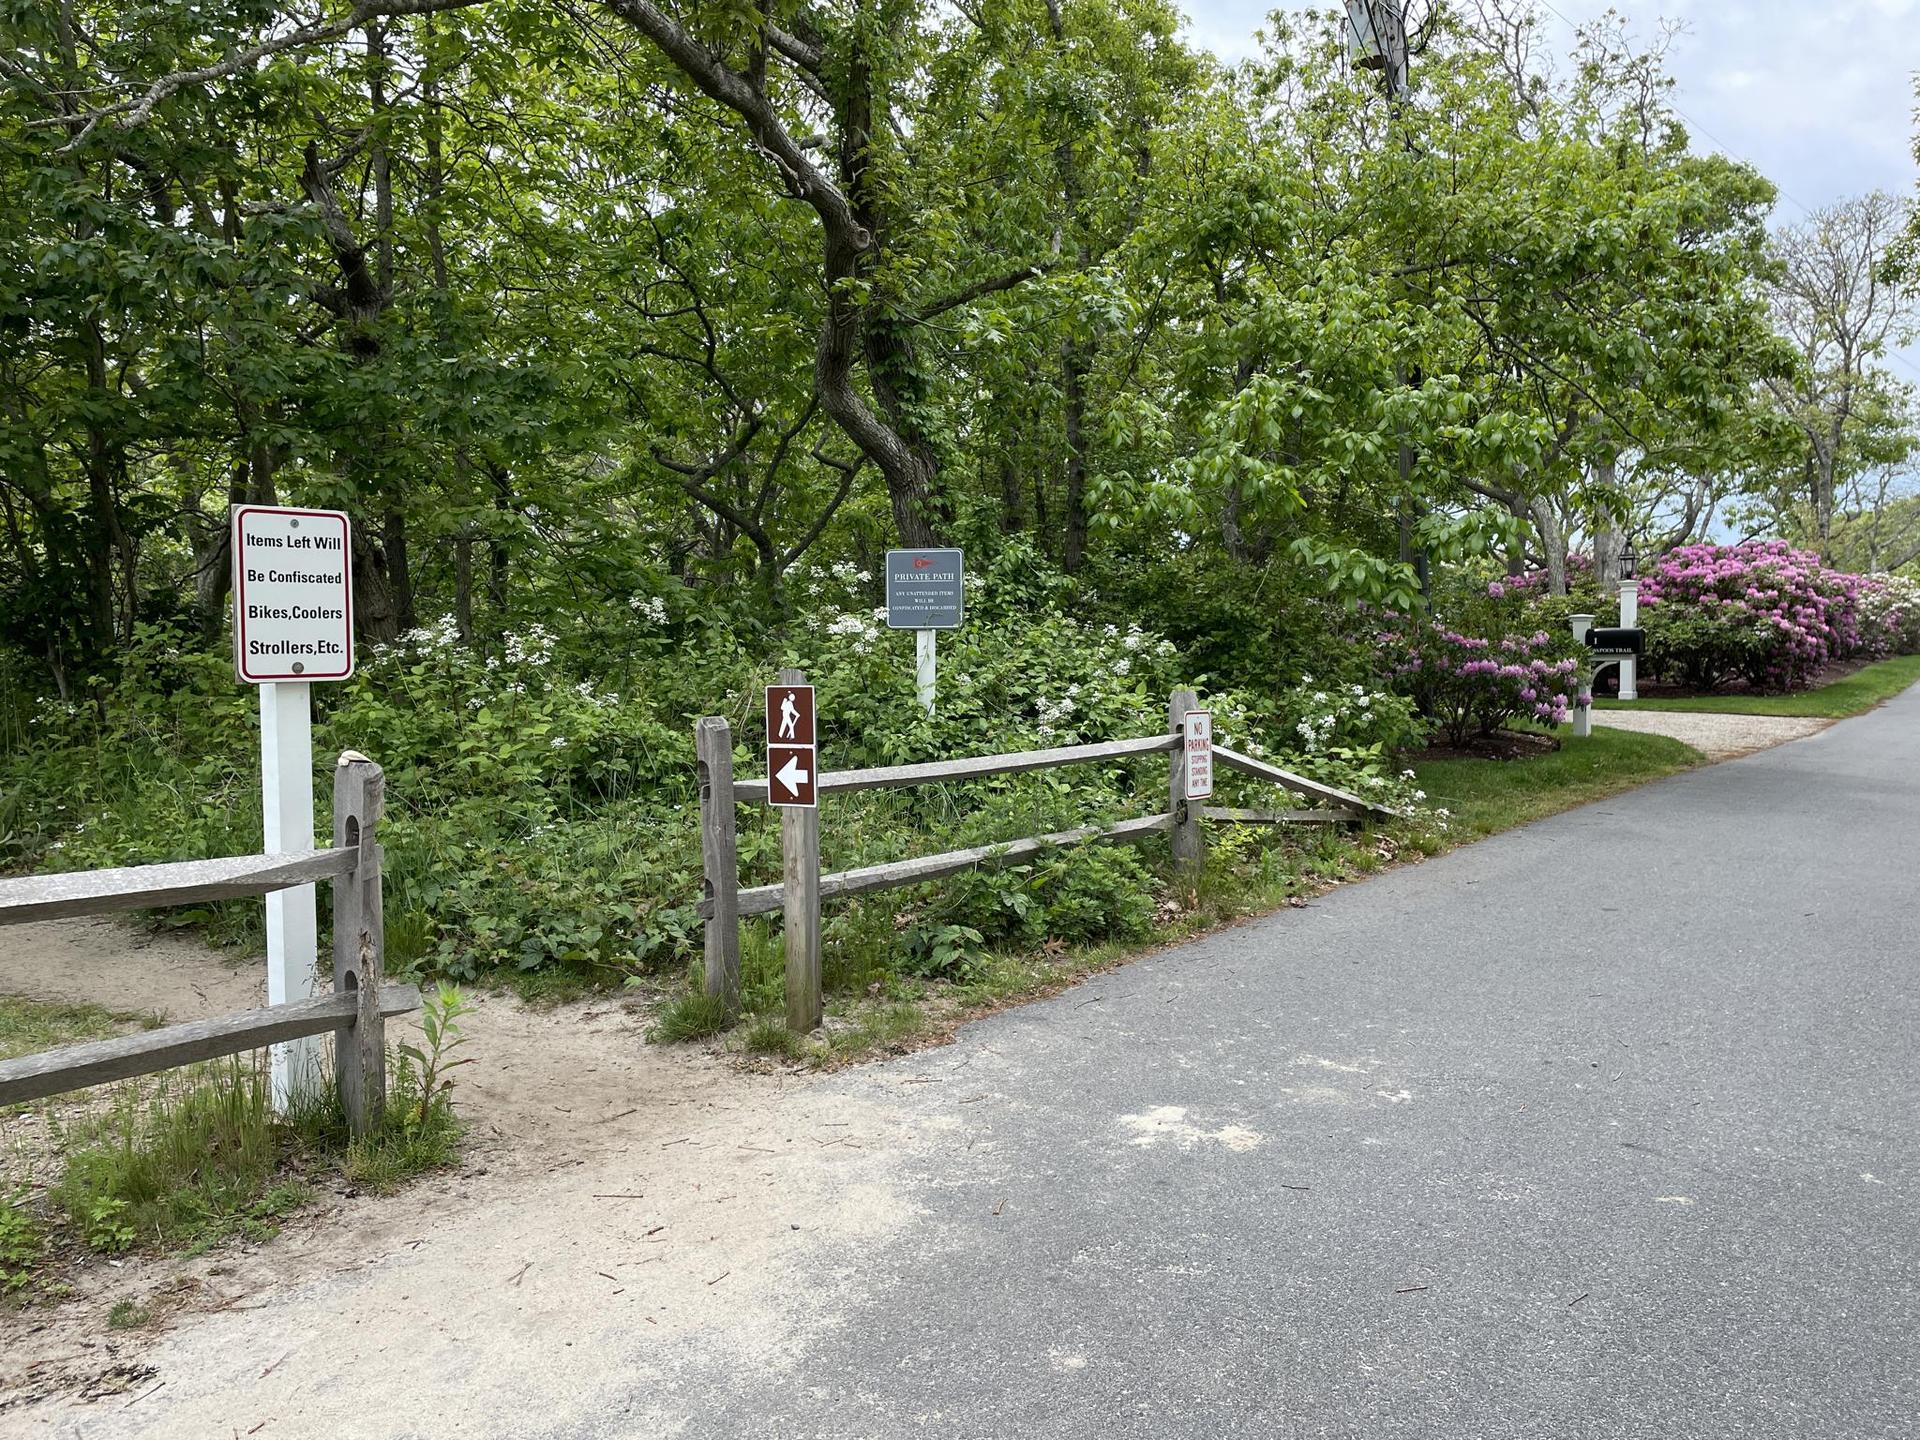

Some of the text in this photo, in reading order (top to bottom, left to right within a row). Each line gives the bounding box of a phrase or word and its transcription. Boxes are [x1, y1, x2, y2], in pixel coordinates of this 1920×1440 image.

[246, 533, 341, 550] Items Left Will
[247, 569, 342, 584] Be Confiscated
[933, 572, 954, 580] PATH
[248, 605, 343, 621] Bikes,Coolers
[249, 640, 344, 655] Strollers,Etc.
[1193, 722, 1202, 735] NO
[1188, 738, 1209, 752] PARKING
[1191, 766, 1208, 776] STANDING
[1199, 778, 1208, 787] TIME
